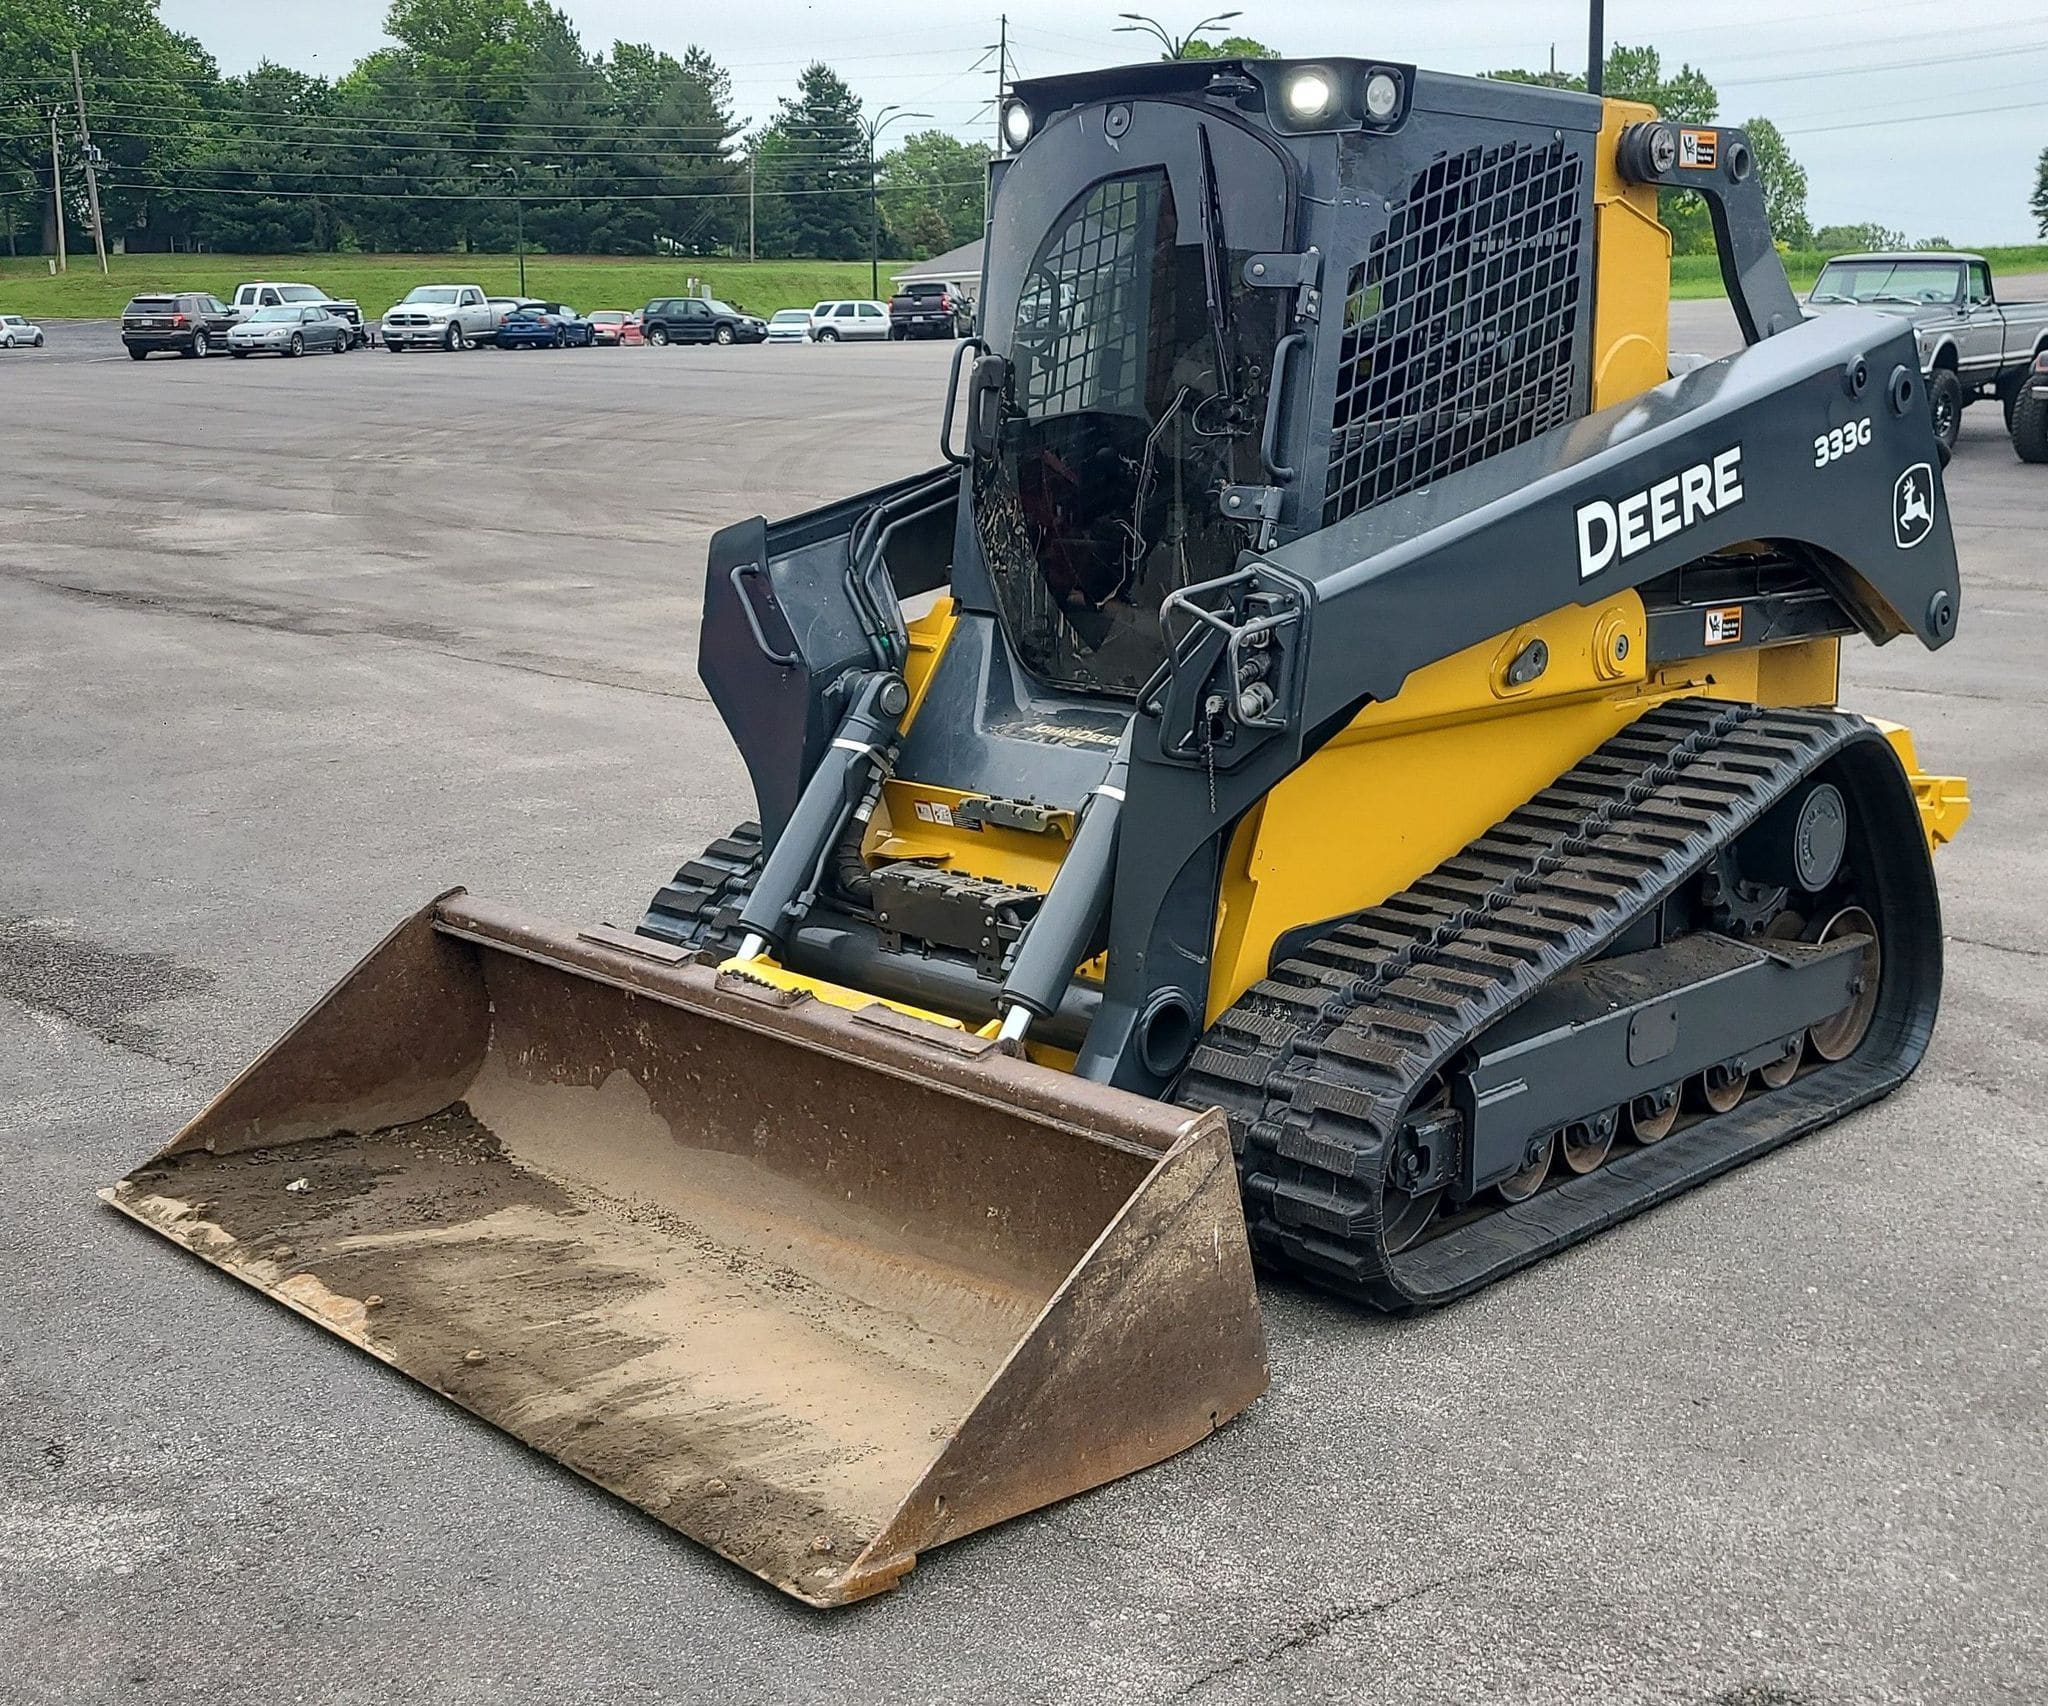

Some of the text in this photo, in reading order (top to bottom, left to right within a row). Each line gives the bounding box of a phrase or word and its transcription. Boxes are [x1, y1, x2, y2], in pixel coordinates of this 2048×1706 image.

[1814, 417, 1872, 468] 333G
[1576, 446, 1744, 579] DEERE
[1073, 730, 1121, 747] DEER
